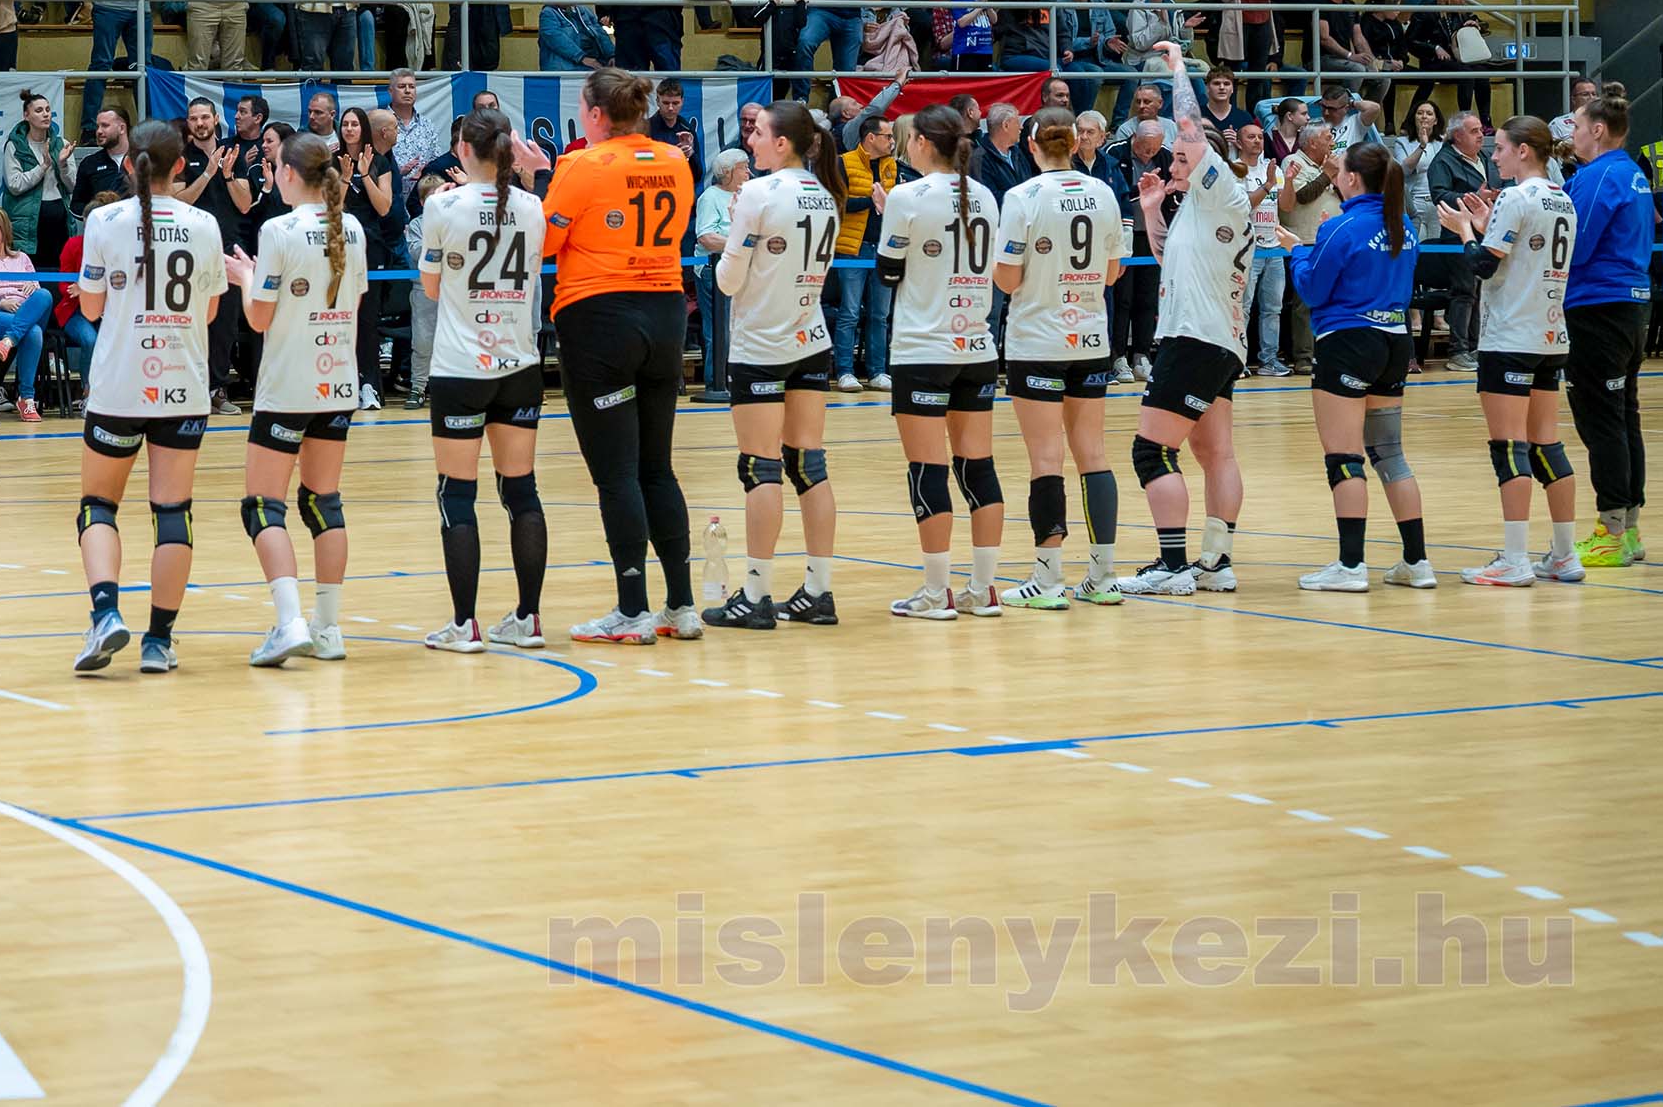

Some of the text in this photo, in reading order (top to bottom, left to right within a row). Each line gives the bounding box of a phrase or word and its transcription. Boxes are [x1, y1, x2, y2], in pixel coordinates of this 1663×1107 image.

[626, 175, 676, 188] WICHMANN
[1060, 195, 1097, 212] KOLLÁR
[628, 189, 677, 247] 12
[796, 214, 836, 272] 14
[1070, 214, 1093, 270] 9
[1551, 216, 1569, 270] 6
[468, 229, 529, 291] 24
[944, 217, 990, 275] 10
[135, 249, 194, 313] 18
[969, 337, 986, 351] K3
[1081, 334, 1101, 348] K3
[164, 388, 186, 404] K3
[334, 383, 353, 398] K3
